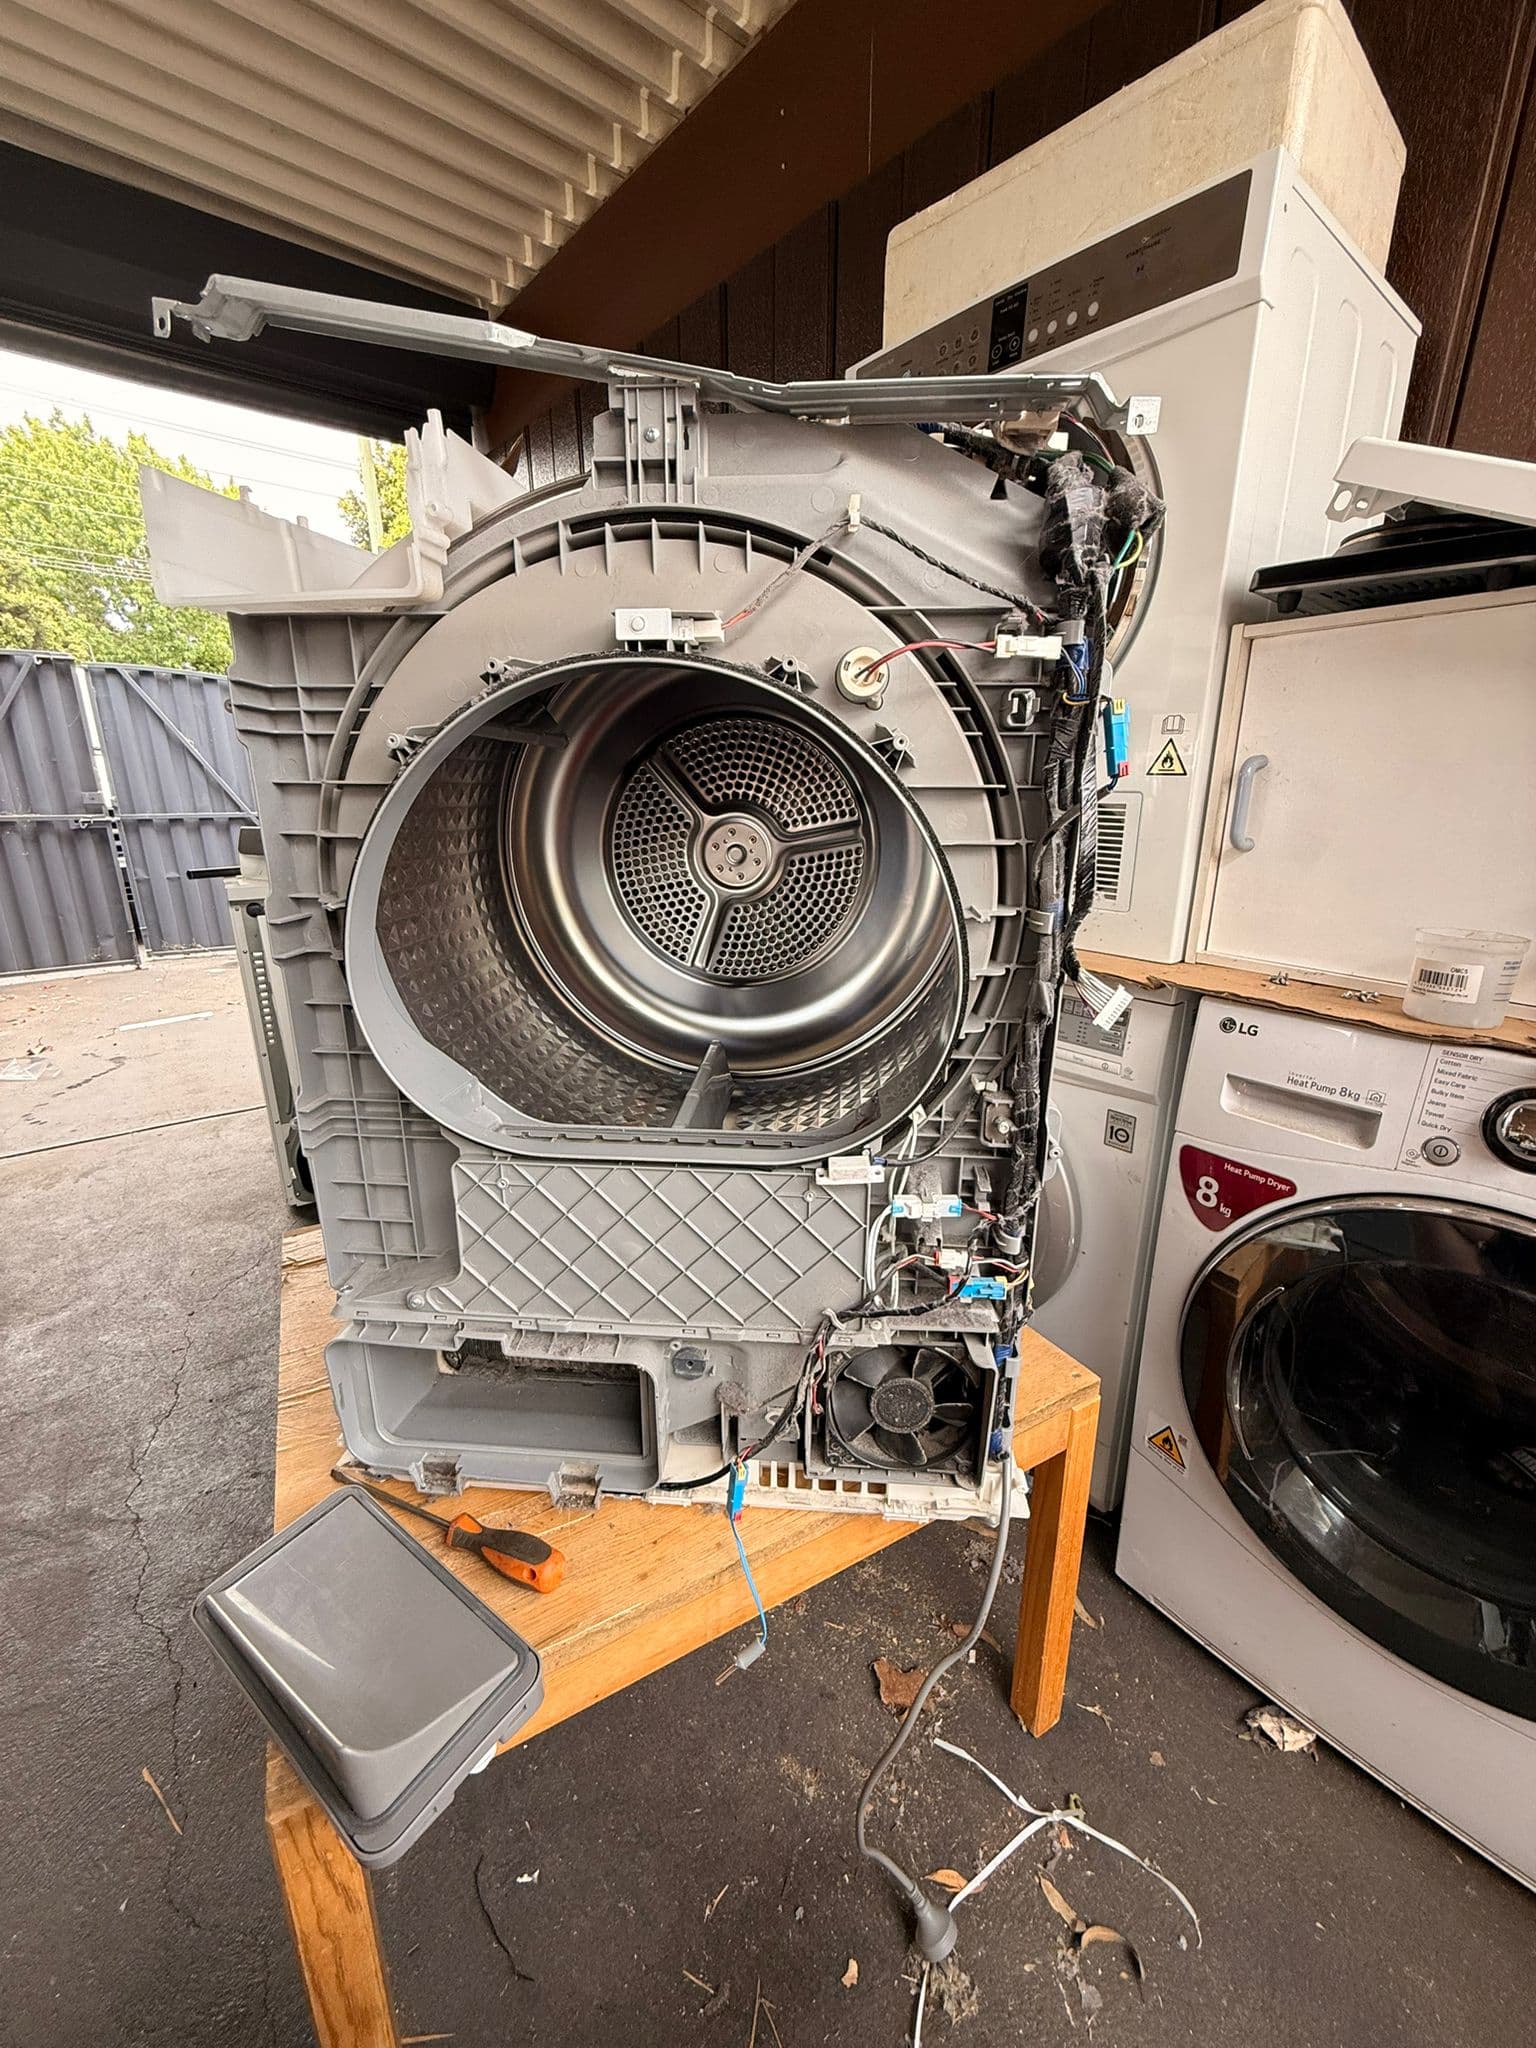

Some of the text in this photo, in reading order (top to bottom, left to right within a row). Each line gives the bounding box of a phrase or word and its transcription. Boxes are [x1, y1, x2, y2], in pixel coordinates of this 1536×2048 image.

[1238, 1022, 1259, 1037] LG
[1441, 1049, 1484, 1062] SENSOR DRY
[1440, 1058, 1462, 1068] Cotton
[1437, 1068, 1478, 1081] Mixed Fabric
[1287, 1076, 1309, 1090] Heat
[1310, 1080, 1337, 1096] Pump
[1434, 1077, 1467, 1089] Easy Care
[1431, 1088, 1465, 1100] Bulky Item
[1427, 1099, 1447, 1108] Jeans
[1424, 1109, 1445, 1119] Towel
[1421, 1120, 1452, 1133] Quick Dry
[1224, 1162, 1291, 1192] Heat Pump Dryer
[1195, 1175, 1219, 1208] 8
[1219, 1203, 1232, 1218] kg
